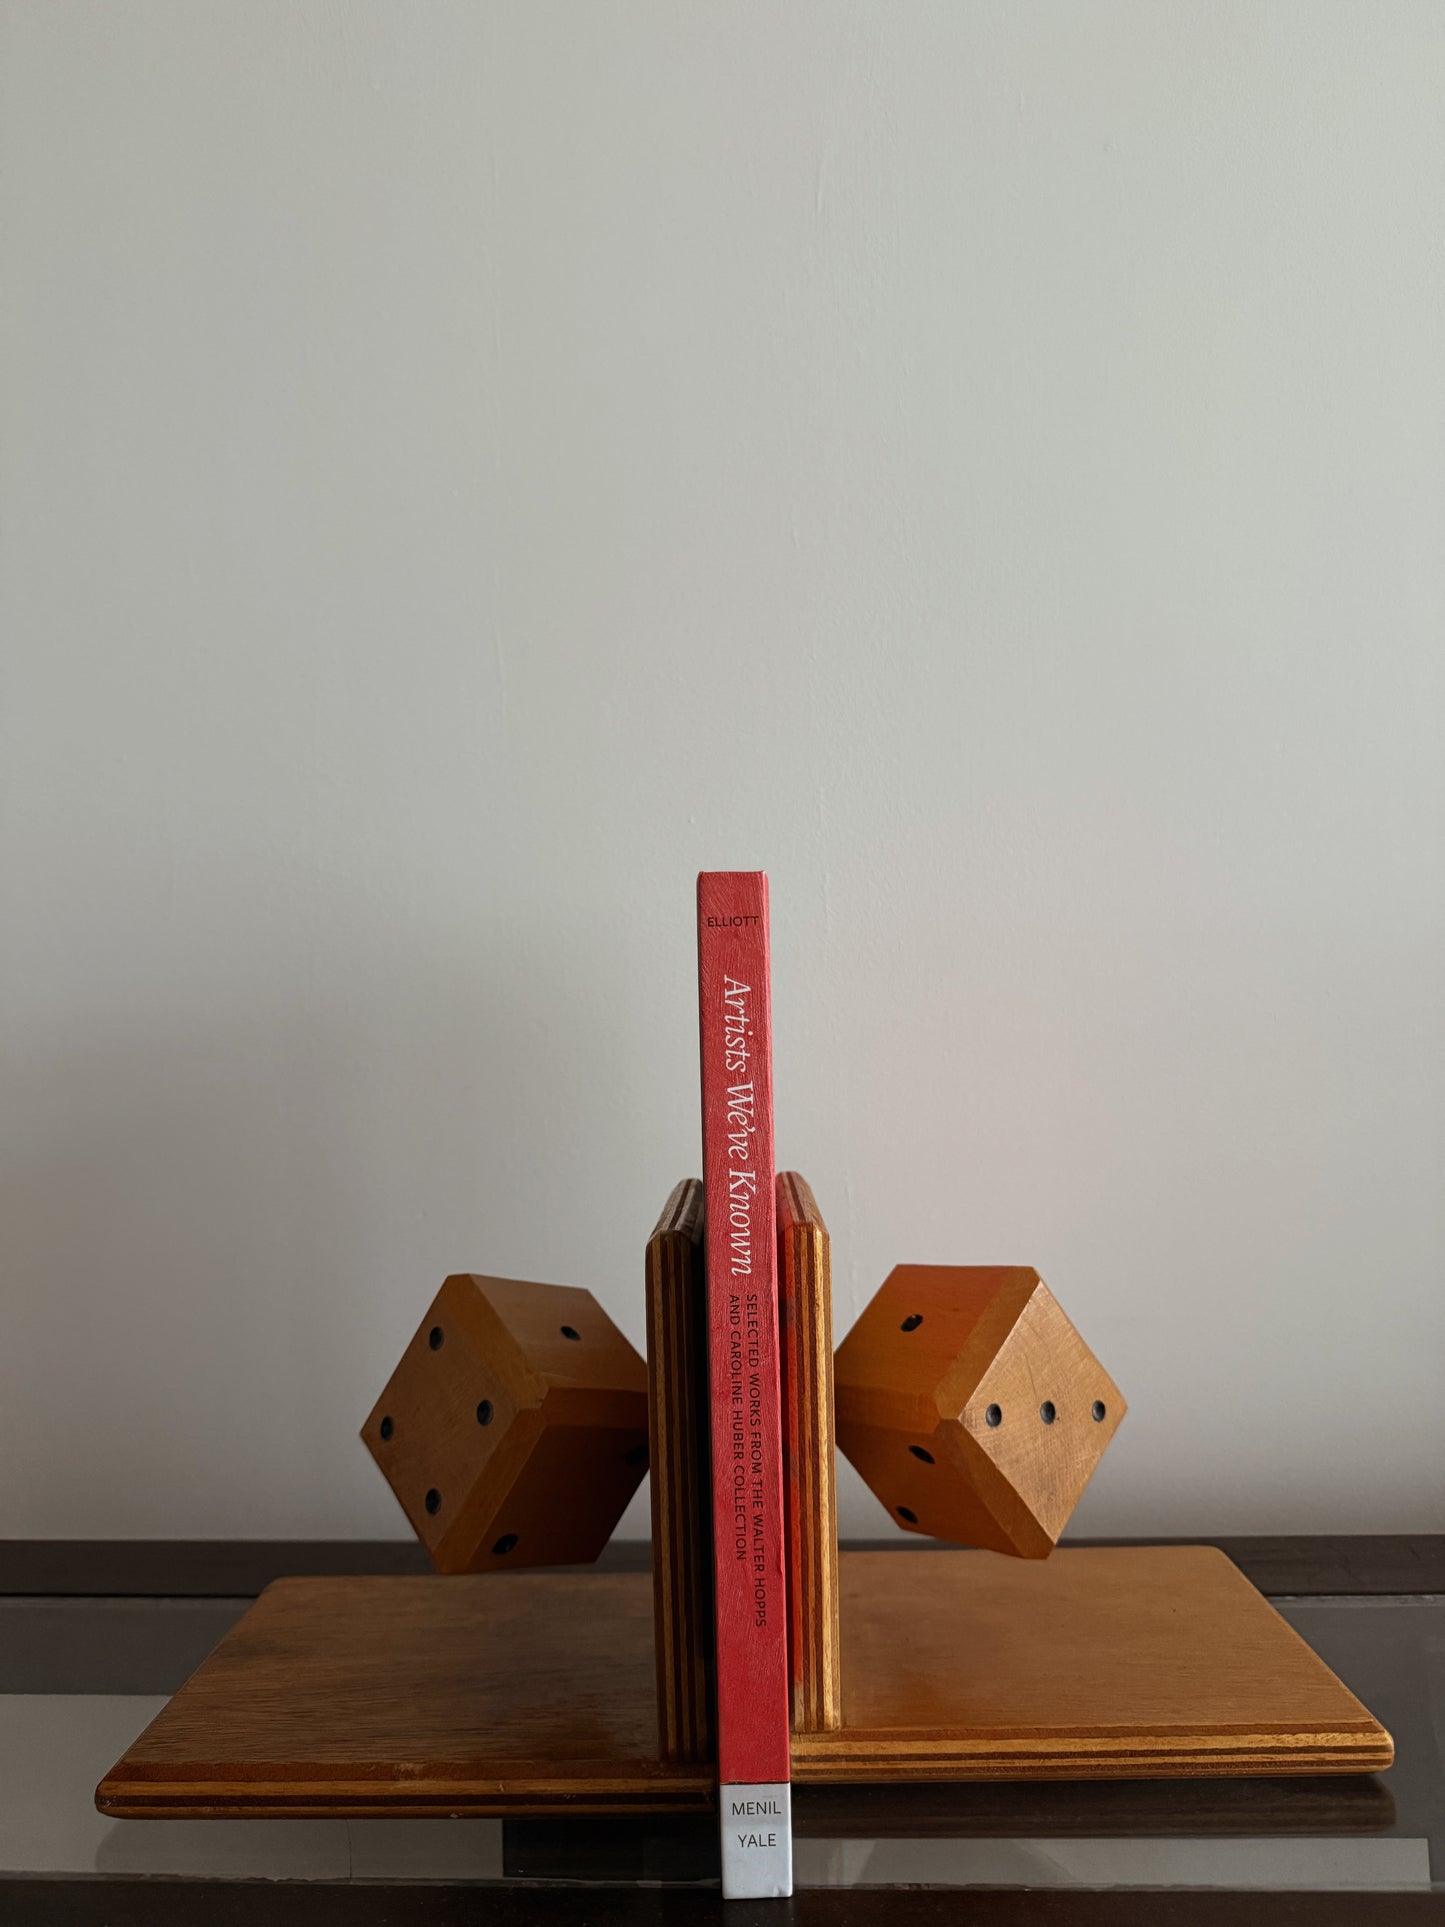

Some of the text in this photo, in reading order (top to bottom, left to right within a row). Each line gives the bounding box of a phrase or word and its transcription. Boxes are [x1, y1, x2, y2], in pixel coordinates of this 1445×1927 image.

[707, 915, 759, 927] ELLIOTT
[723, 974, 753, 1073] Artists
[728, 1166, 757, 1276] Known
[729, 1294, 746, 1561] AND CAROLINE HUBER COLLECTION
[746, 1294, 767, 1627] SELECTED WORKS FROM THE WALTER HOPPS
[732, 1801, 782, 1816] MENIL
[737, 1832, 777, 1848] YALE
